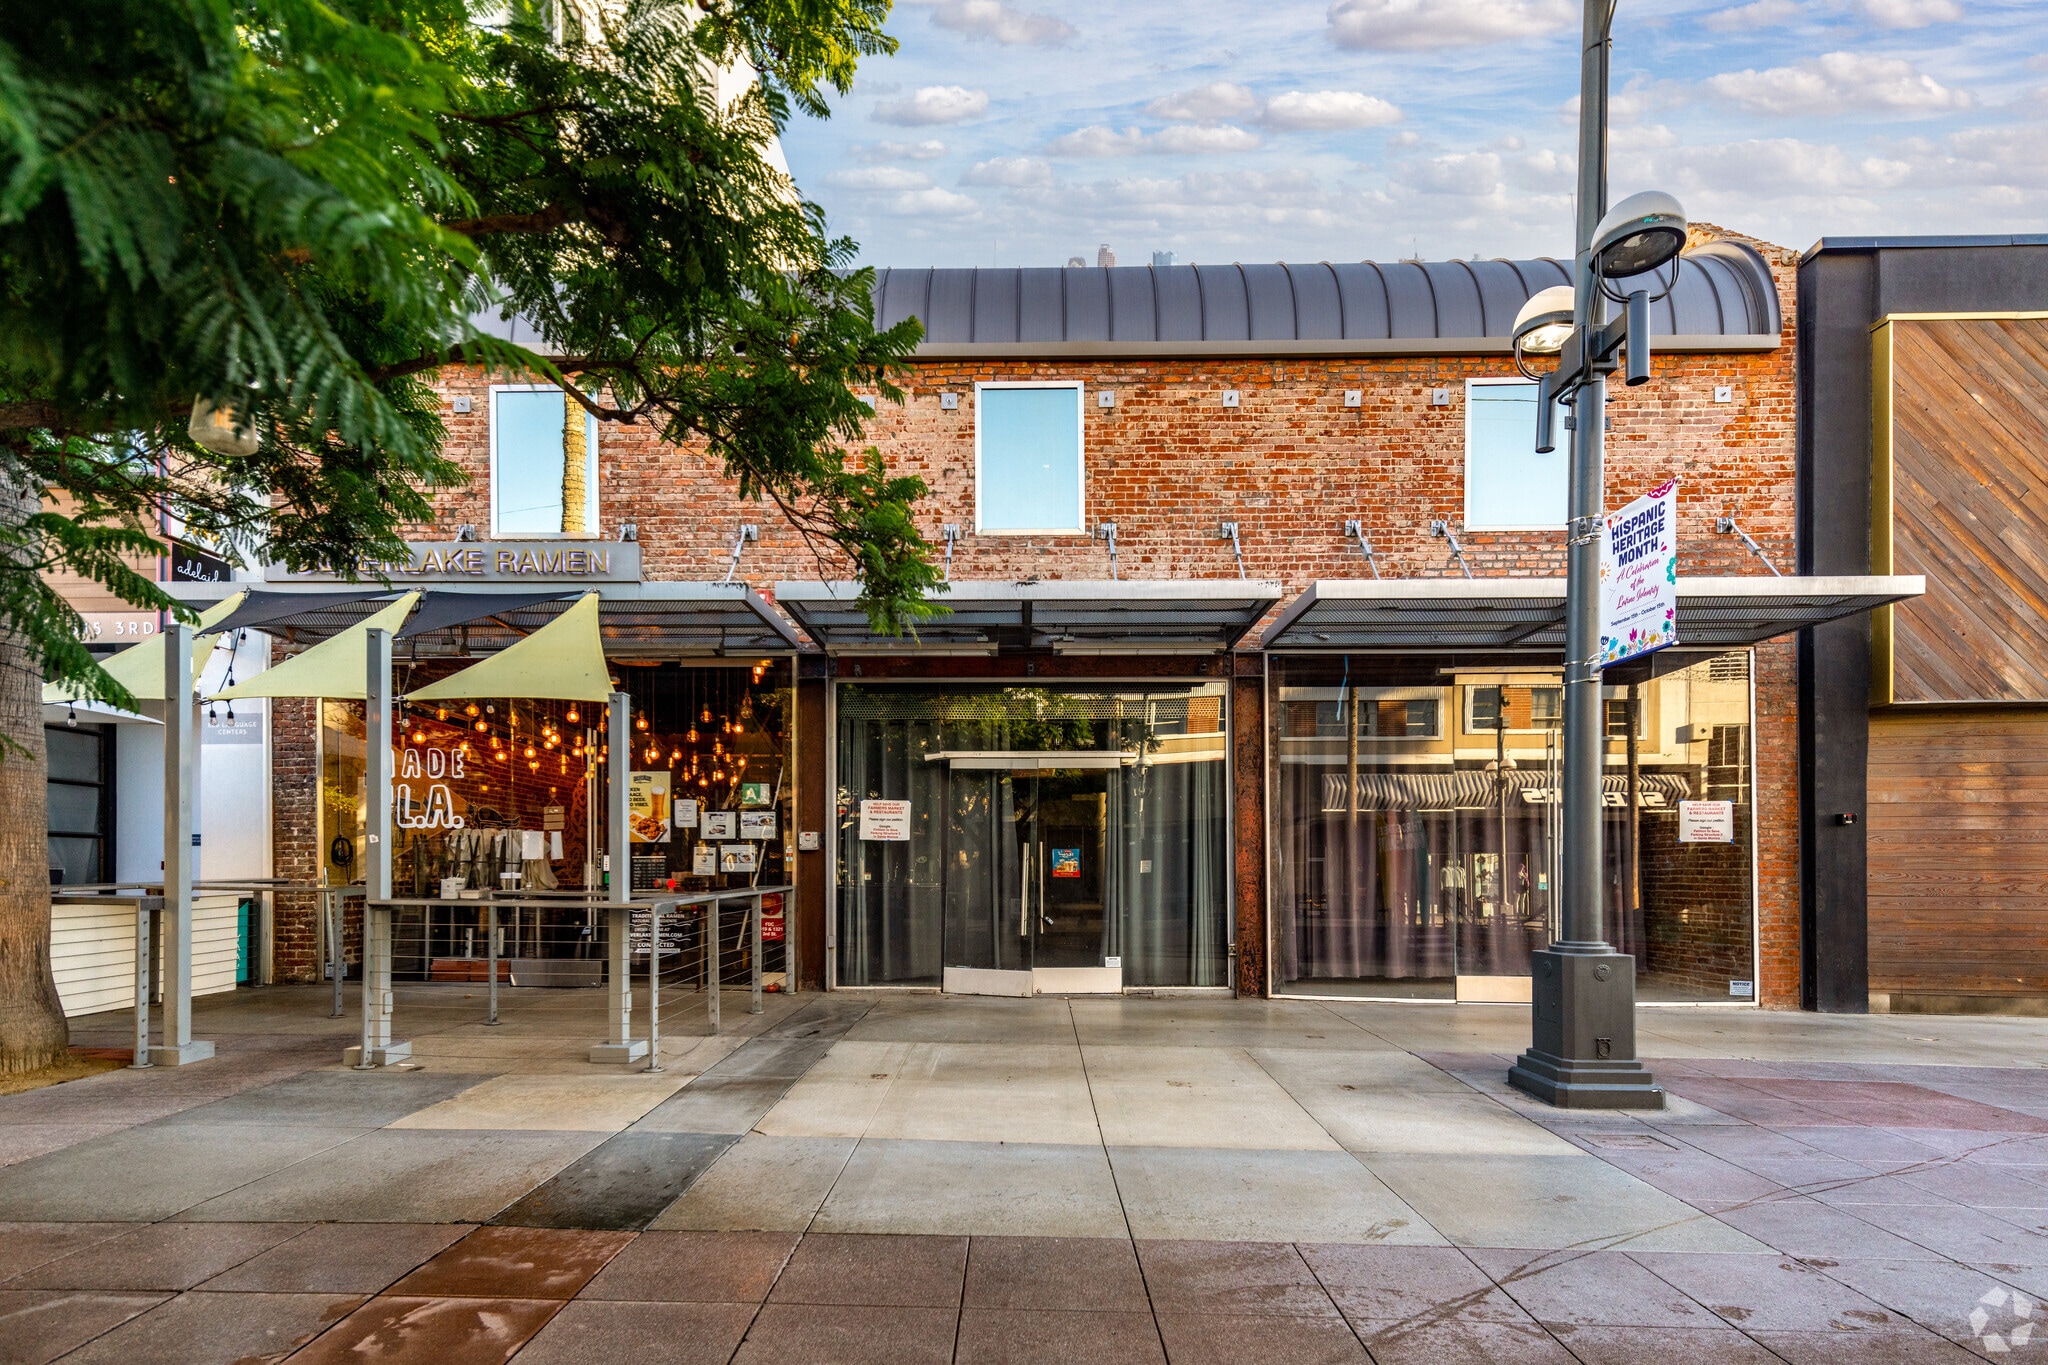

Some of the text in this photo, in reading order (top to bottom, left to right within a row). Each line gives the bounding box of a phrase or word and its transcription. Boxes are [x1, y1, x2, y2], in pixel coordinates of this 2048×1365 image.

[1611, 501, 1665, 541] HISPANIC
[1612, 517, 1665, 555] HERITAGE
[494, 549, 608, 573] RAMEN
[1618, 536, 1658, 567] MONTH
[177, 560, 223, 582] adelaid
[1616, 558, 1659, 584] A Celebration
[1630, 575, 1644, 591] of the
[1636, 584, 1660, 602] Identity
[115, 621, 154, 635] 3RD
[1610, 615, 1631, 627] September
[1640, 606, 1656, 616] October
[397, 784, 465, 829] L.A.
